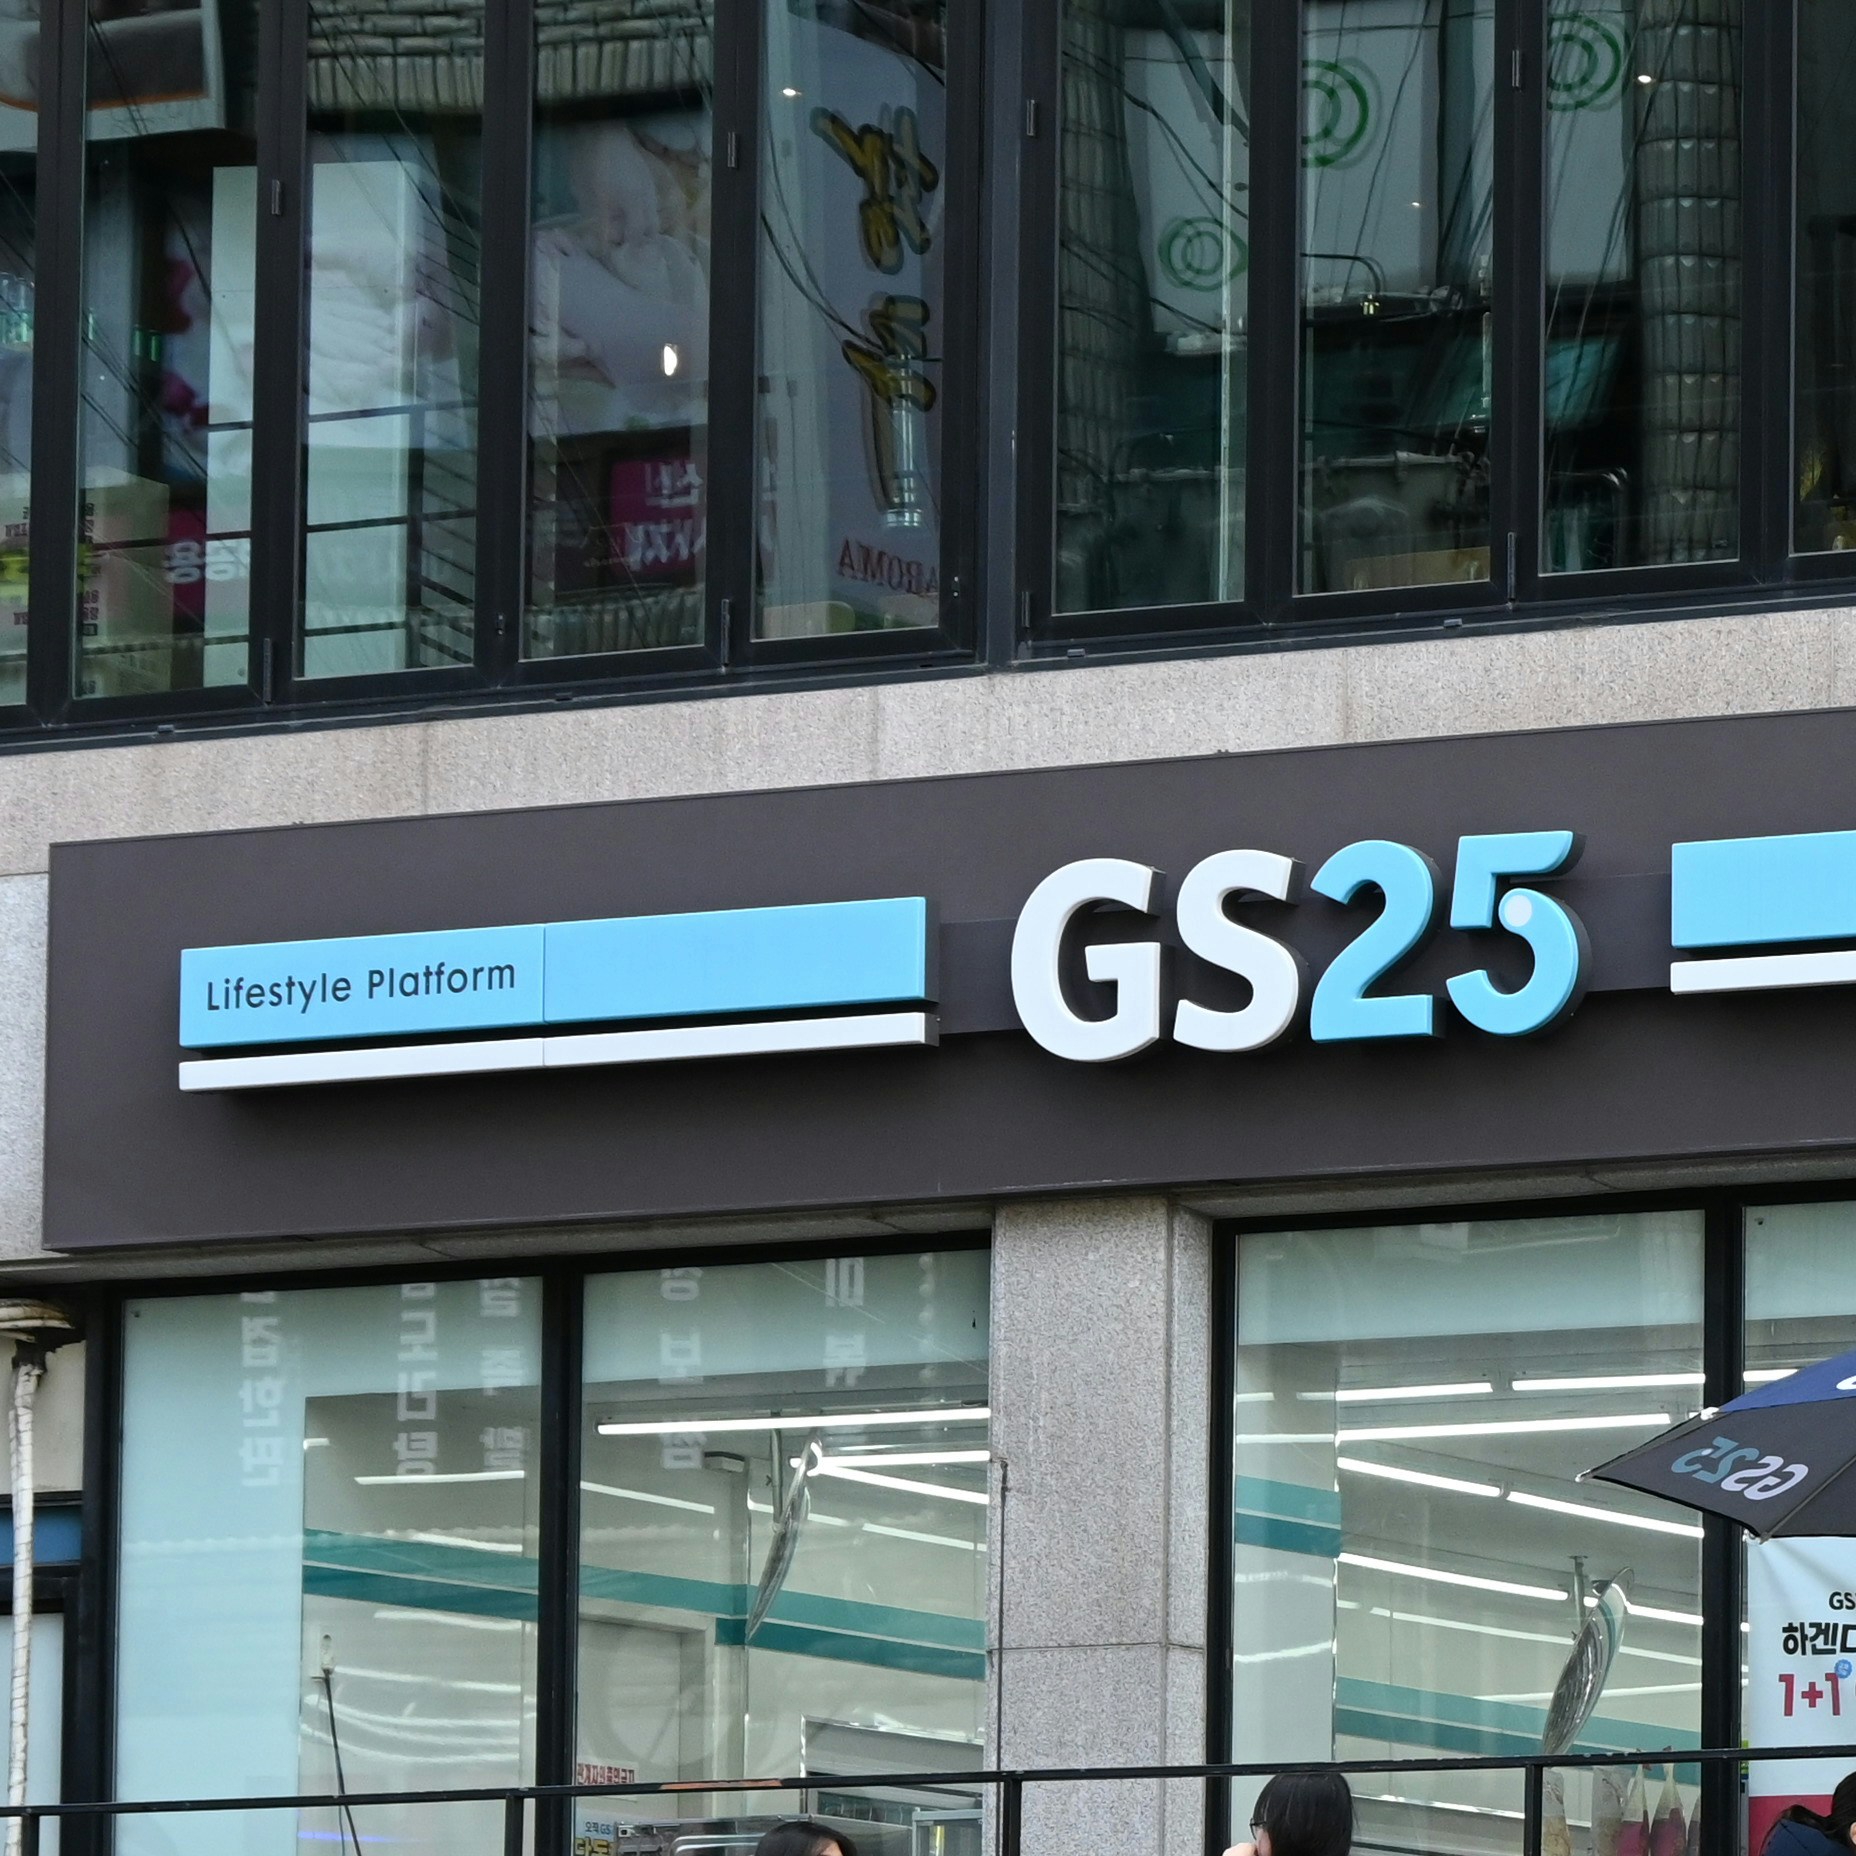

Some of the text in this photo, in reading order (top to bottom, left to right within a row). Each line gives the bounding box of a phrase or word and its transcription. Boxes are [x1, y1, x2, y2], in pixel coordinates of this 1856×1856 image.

[1011, 830, 1581, 1062] GS25
[206, 957, 516, 1014] Lifestyle Platform
[1778, 1672, 1841, 1717] 1+1
